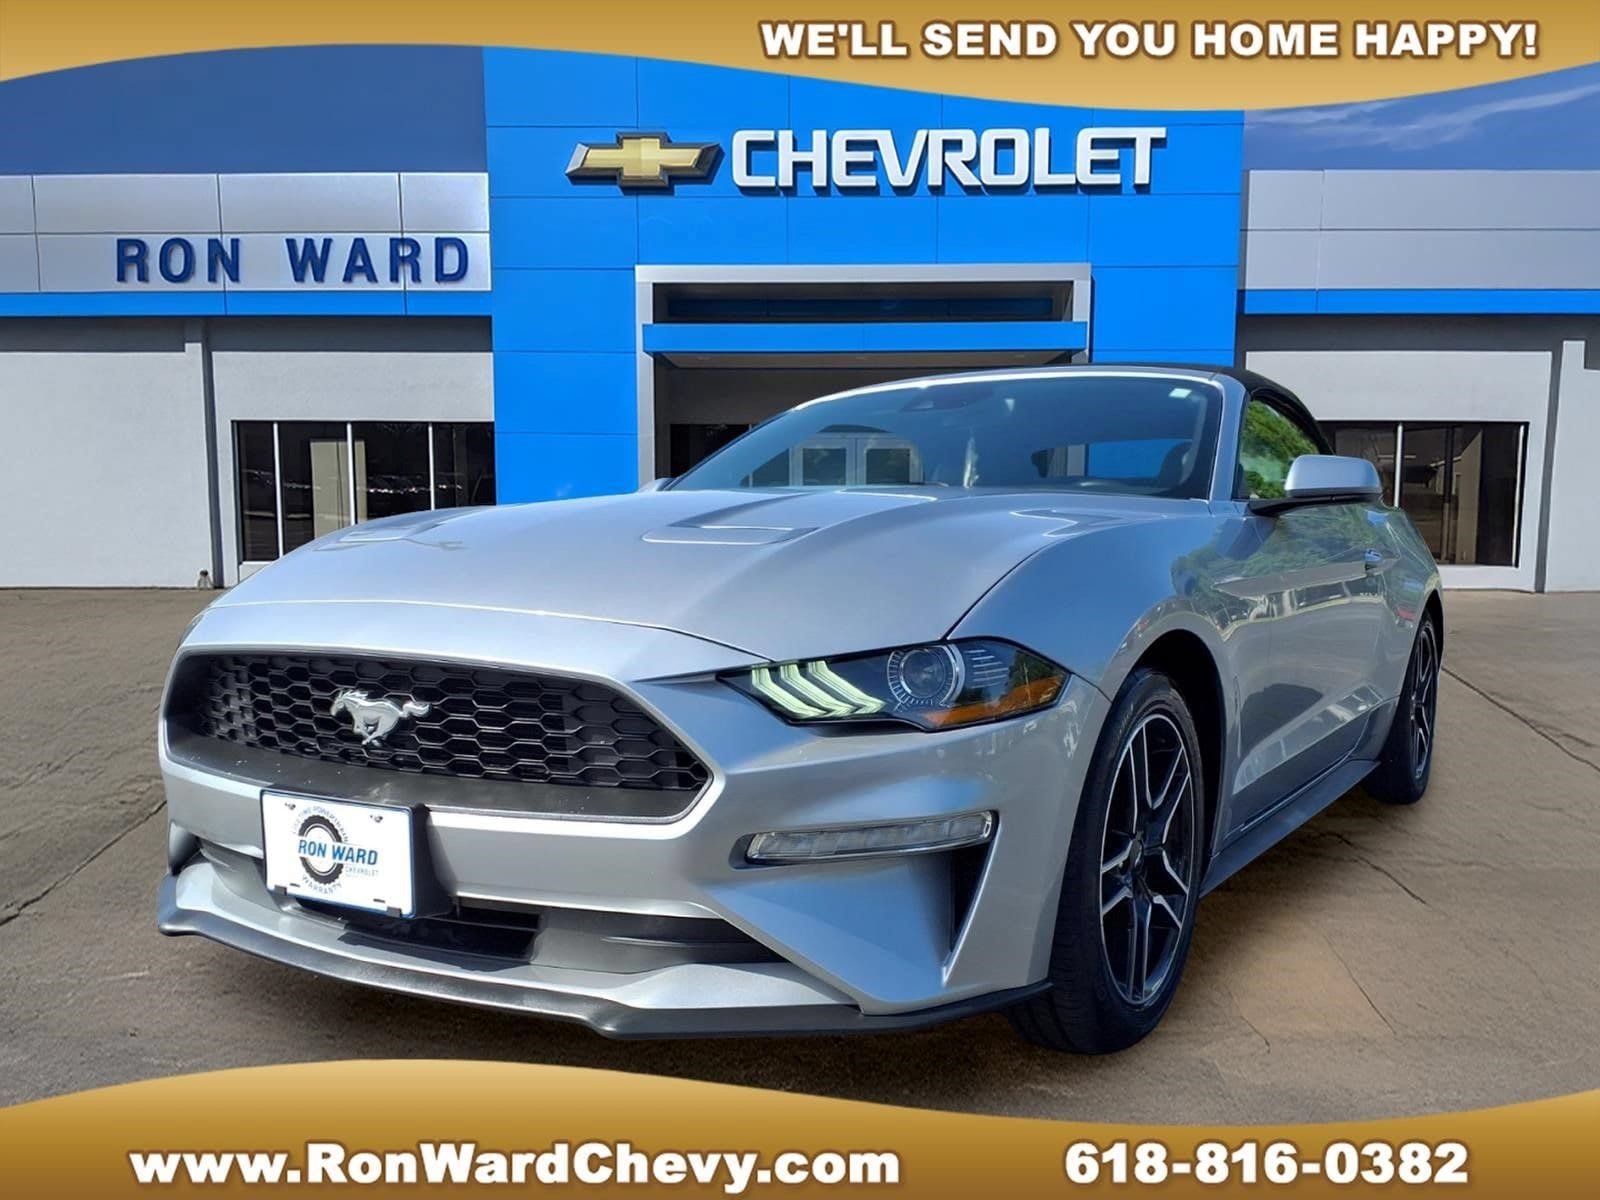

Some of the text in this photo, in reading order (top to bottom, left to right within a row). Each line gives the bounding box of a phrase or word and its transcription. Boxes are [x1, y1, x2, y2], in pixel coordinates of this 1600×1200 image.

[732, 127, 1166, 190] CHEVROLET
[115, 237, 470, 283] RON WARD
[298, 839, 378, 865] RON WARD
[302, 875, 342, 894] WARRANTY
